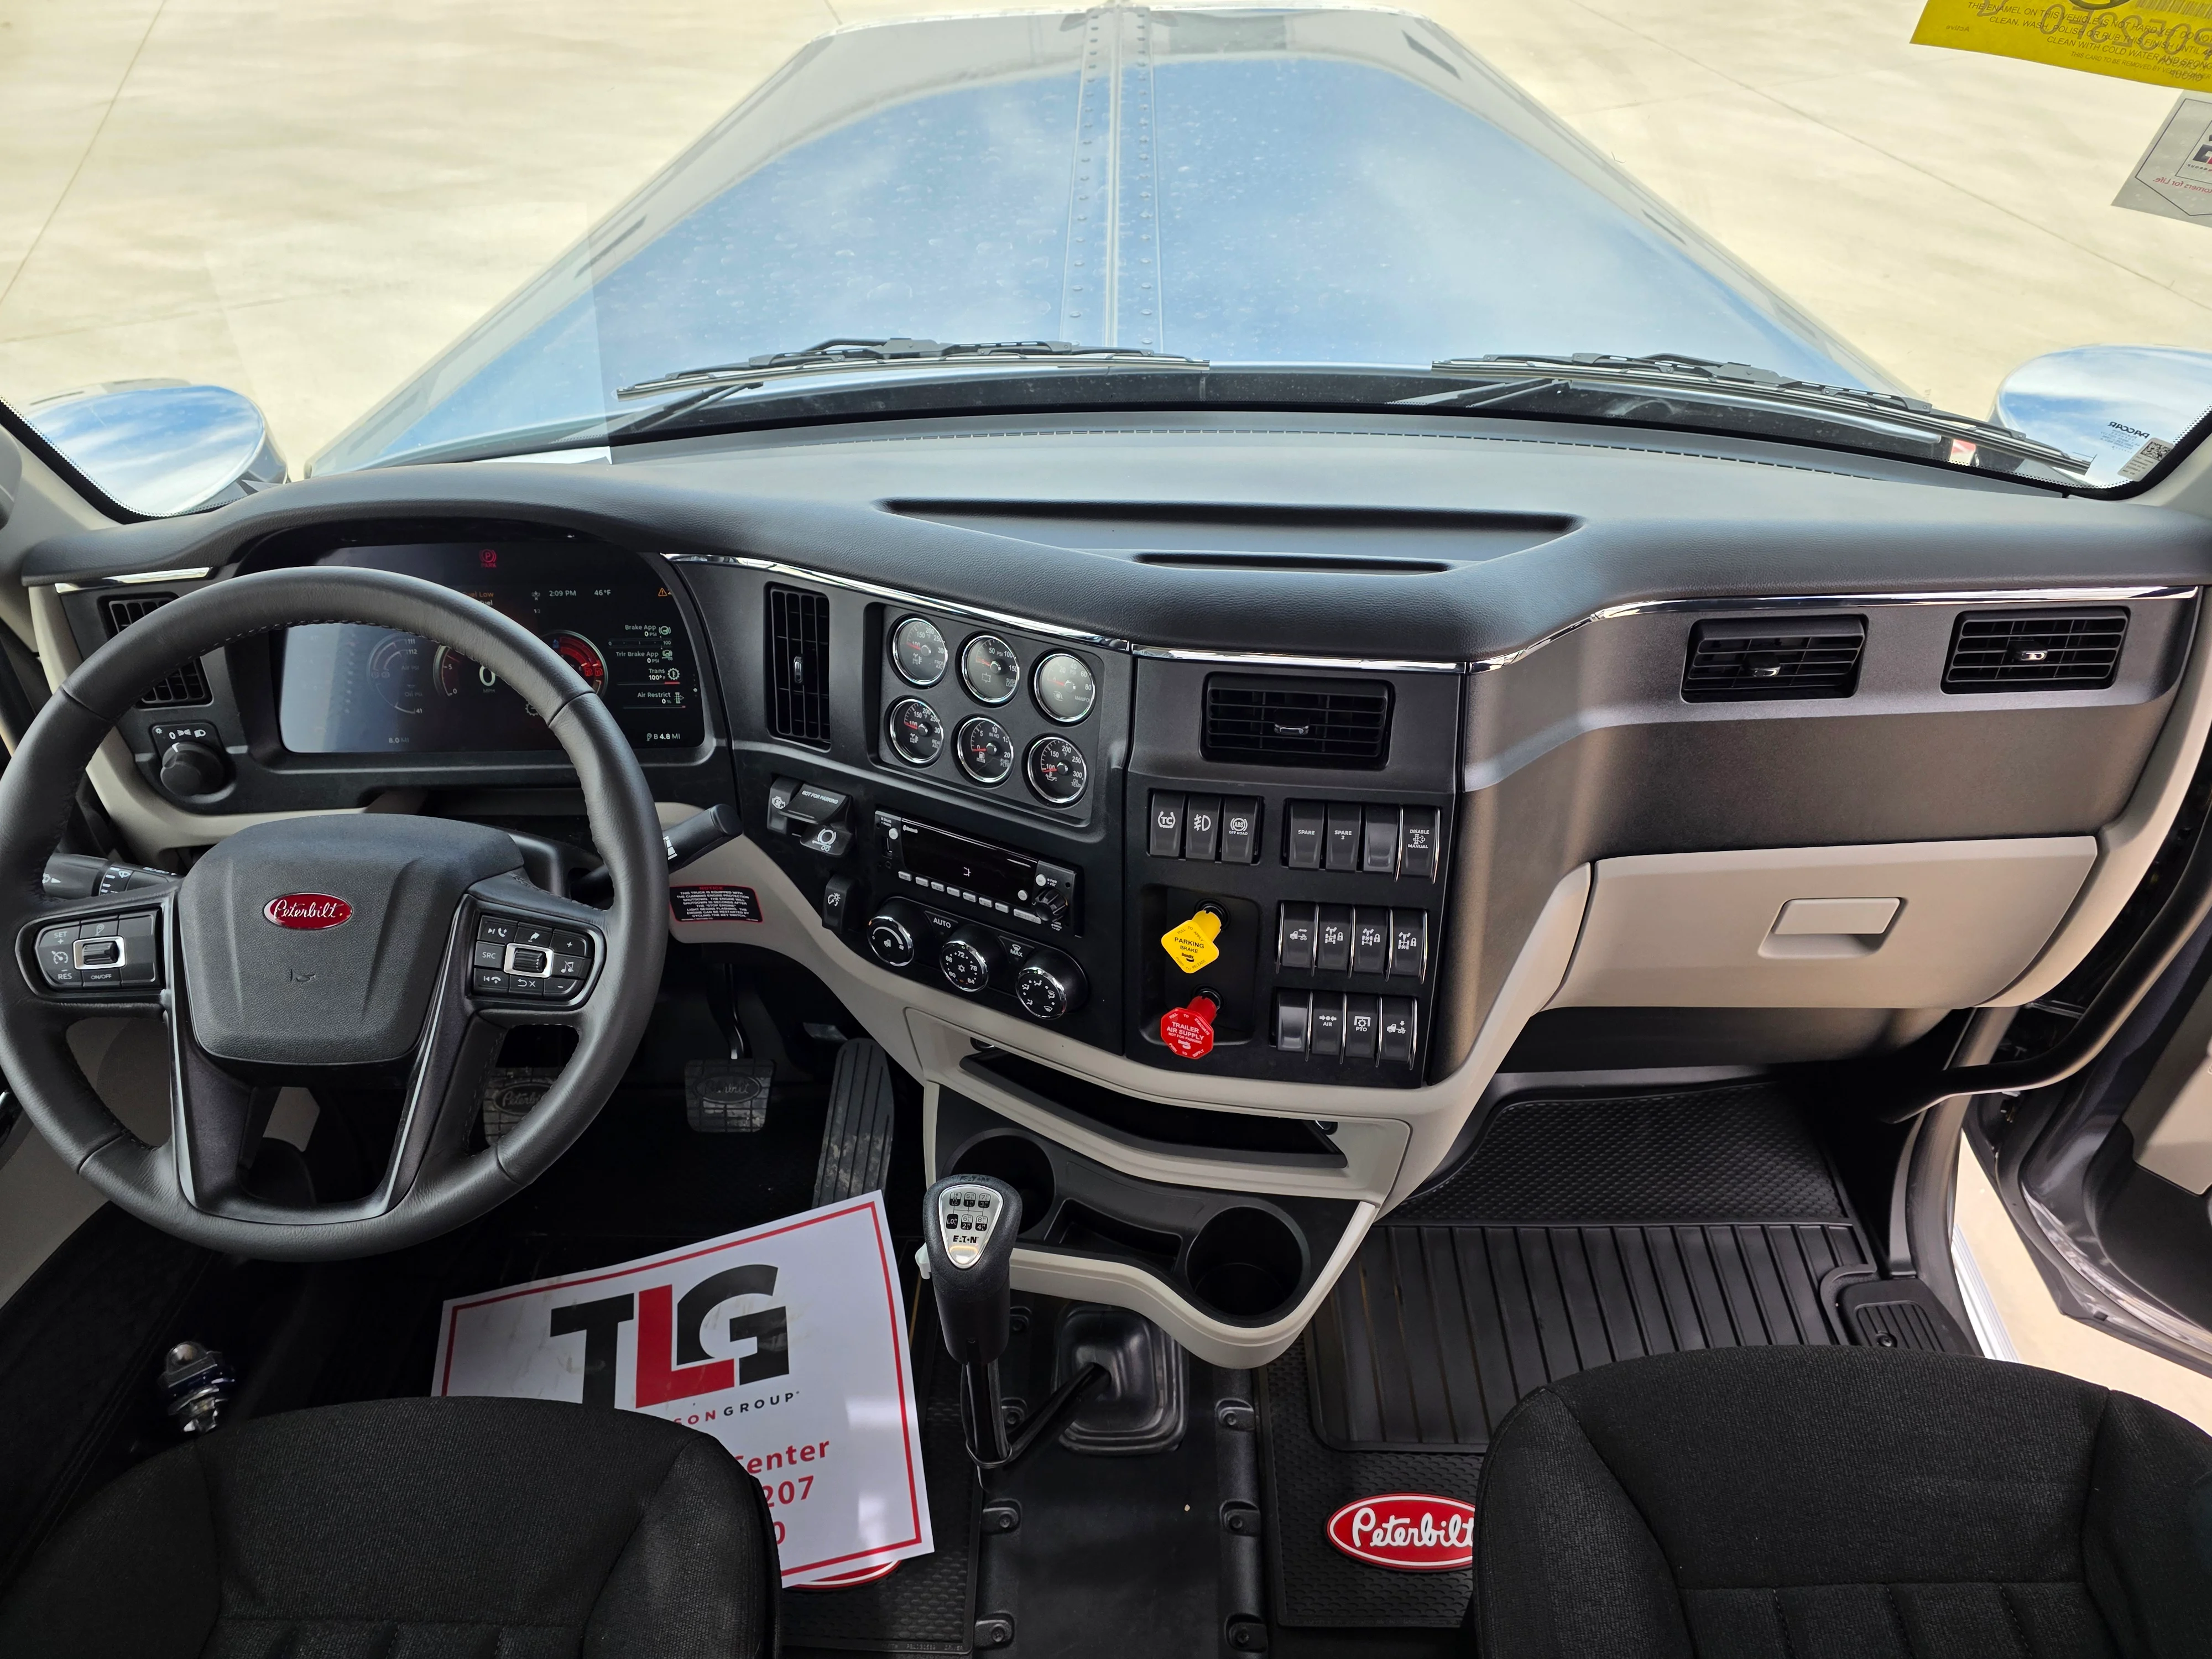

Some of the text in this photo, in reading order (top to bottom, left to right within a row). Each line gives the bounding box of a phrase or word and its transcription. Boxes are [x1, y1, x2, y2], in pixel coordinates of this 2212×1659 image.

[1968, 2, 1984, 10] THE
[1986, 4, 2021, 14] ENAMEL
[2040, 9, 2059, 19] THIS
[1989, 16, 2020, 26] CLEAN,
[2053, 25, 2084, 36] POLISH
[2101, 32, 2120, 41] RUB
[2047, 36, 2159, 61] CLEAN WITH COLD WATER
[2121, 60, 2151, 71] REMOVED
[479, 665, 496, 686] 0
[820, 795, 839, 805] PARKING
[1161, 816, 1173, 825] TC
[274, 899, 344, 919] Peterbilt
[933, 917, 951, 928] AUTO
[1193, 931, 1204, 942] APPLY
[1175, 937, 1204, 948] PARKING
[1010, 948, 1022, 957] MAX
[1180, 945, 1198, 953] BRAKE
[1192, 959, 1206, 969] RELEASE
[1172, 1021, 1199, 1034] TRAILER
[1194, 1018, 1210, 1036] EVACUATE
[1178, 1029, 1204, 1041] SUPPLY
[953, 1235, 977, 1243] EATON
[550, 1264, 789, 1408] TLG
[1352, 1507, 1474, 1548] Peterbilt
